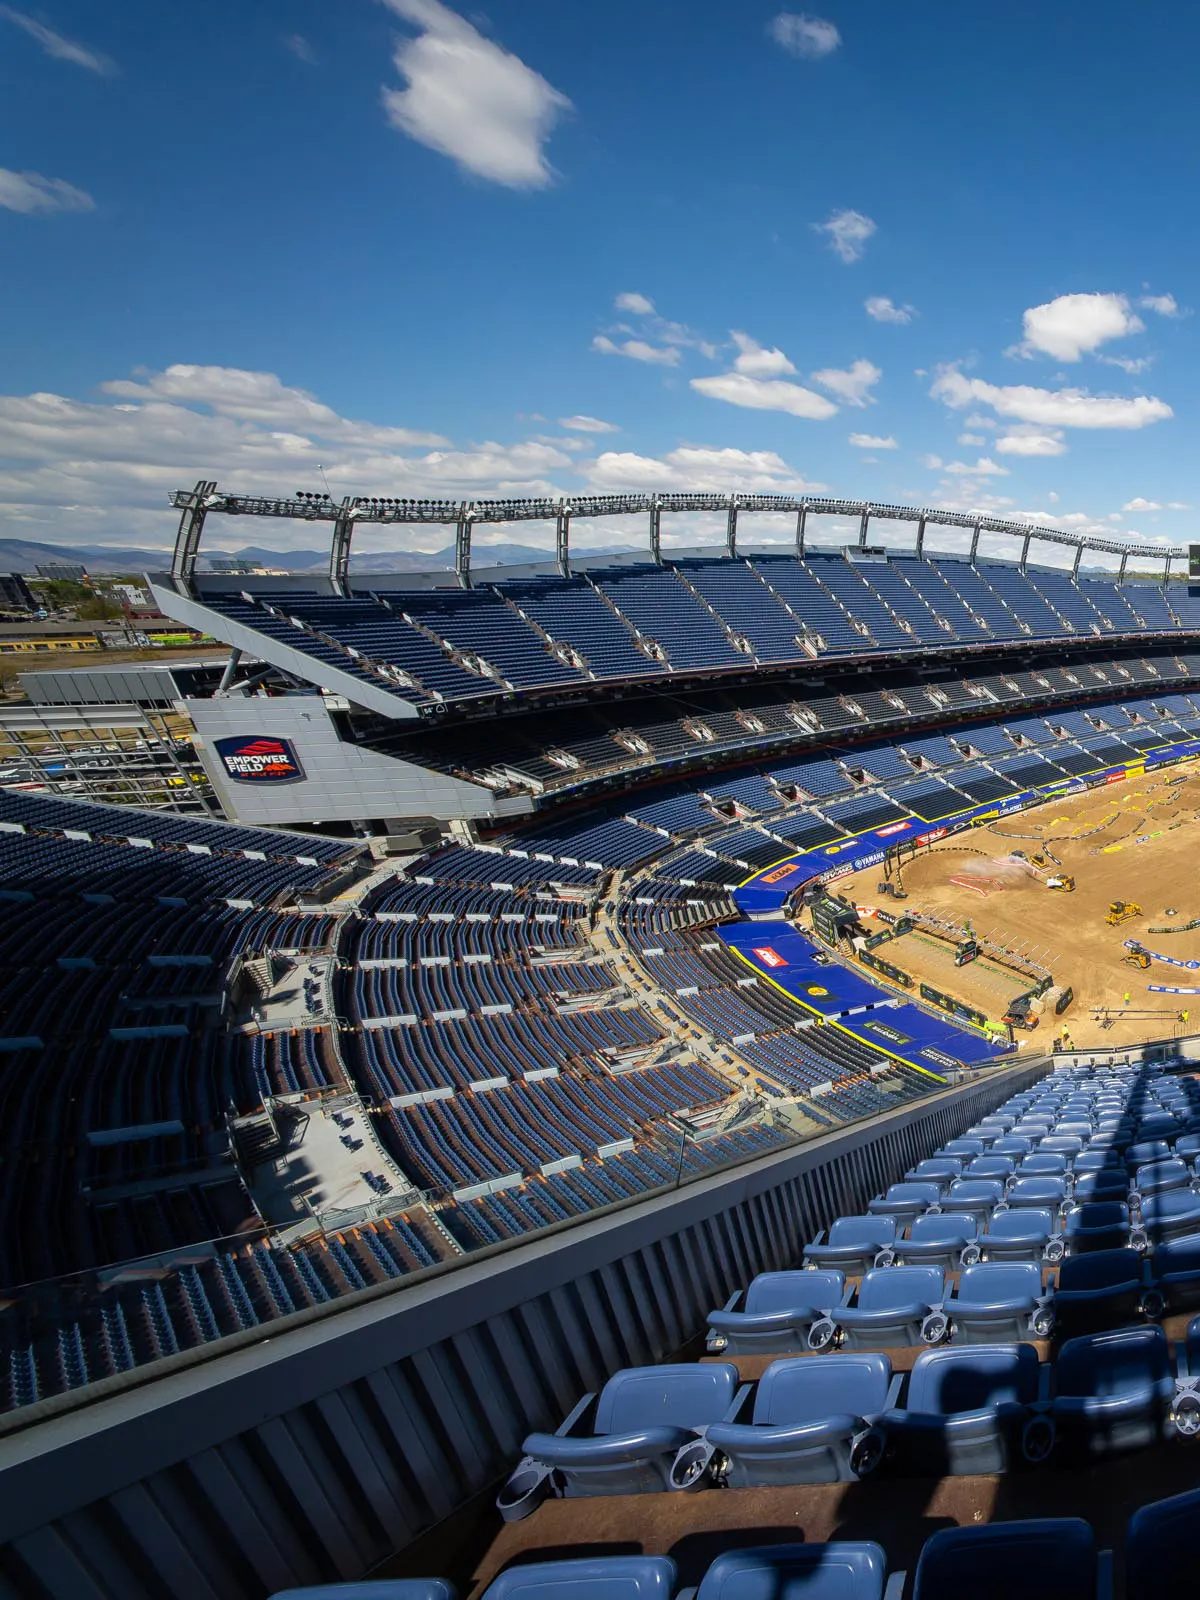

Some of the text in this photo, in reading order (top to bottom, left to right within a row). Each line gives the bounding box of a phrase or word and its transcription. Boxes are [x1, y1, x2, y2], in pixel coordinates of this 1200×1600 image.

[224, 754, 289, 765] EMPOWER
[228, 763, 264, 773] FIELD
[861, 852, 885, 866] YAMAHA
